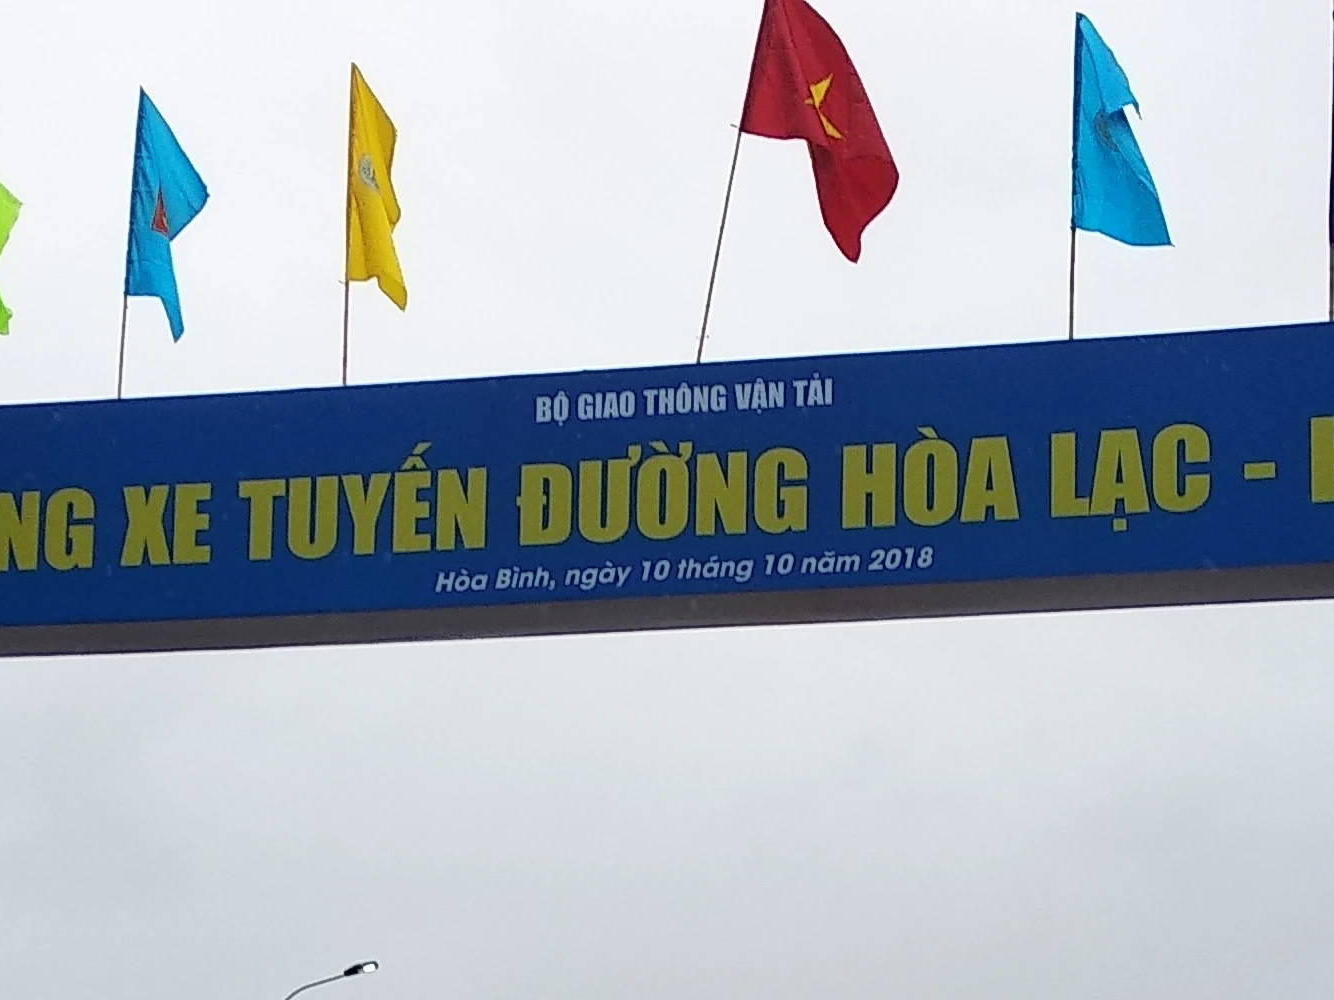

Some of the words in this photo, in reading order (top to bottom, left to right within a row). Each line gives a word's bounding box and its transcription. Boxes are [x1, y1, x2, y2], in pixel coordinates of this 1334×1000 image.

[534, 390, 569, 427] BỘ
[577, 390, 636, 421] GIAO
[643, 382, 728, 416] THÔNG
[734, 377, 785, 415] VẬN
[792, 371, 834, 407] TẢI
[119, 481, 212, 567] XE
[238, 440, 488, 562] TUYẾN
[516, 440, 810, 547] ĐƯỜNG
[840, 425, 1021, 531] HÒA
[1049, 422, 1213, 532] LẠC
[434, 570, 487, 594] Hòa
[495, 566, 556, 592] Bình,
[565, 561, 632, 591] ngày
[640, 559, 670, 582] 10
[677, 556, 754, 585] tháng
[764, 554, 794, 577] 10
[800, 551, 861, 575] năm
[867, 546, 935, 571] 2018
